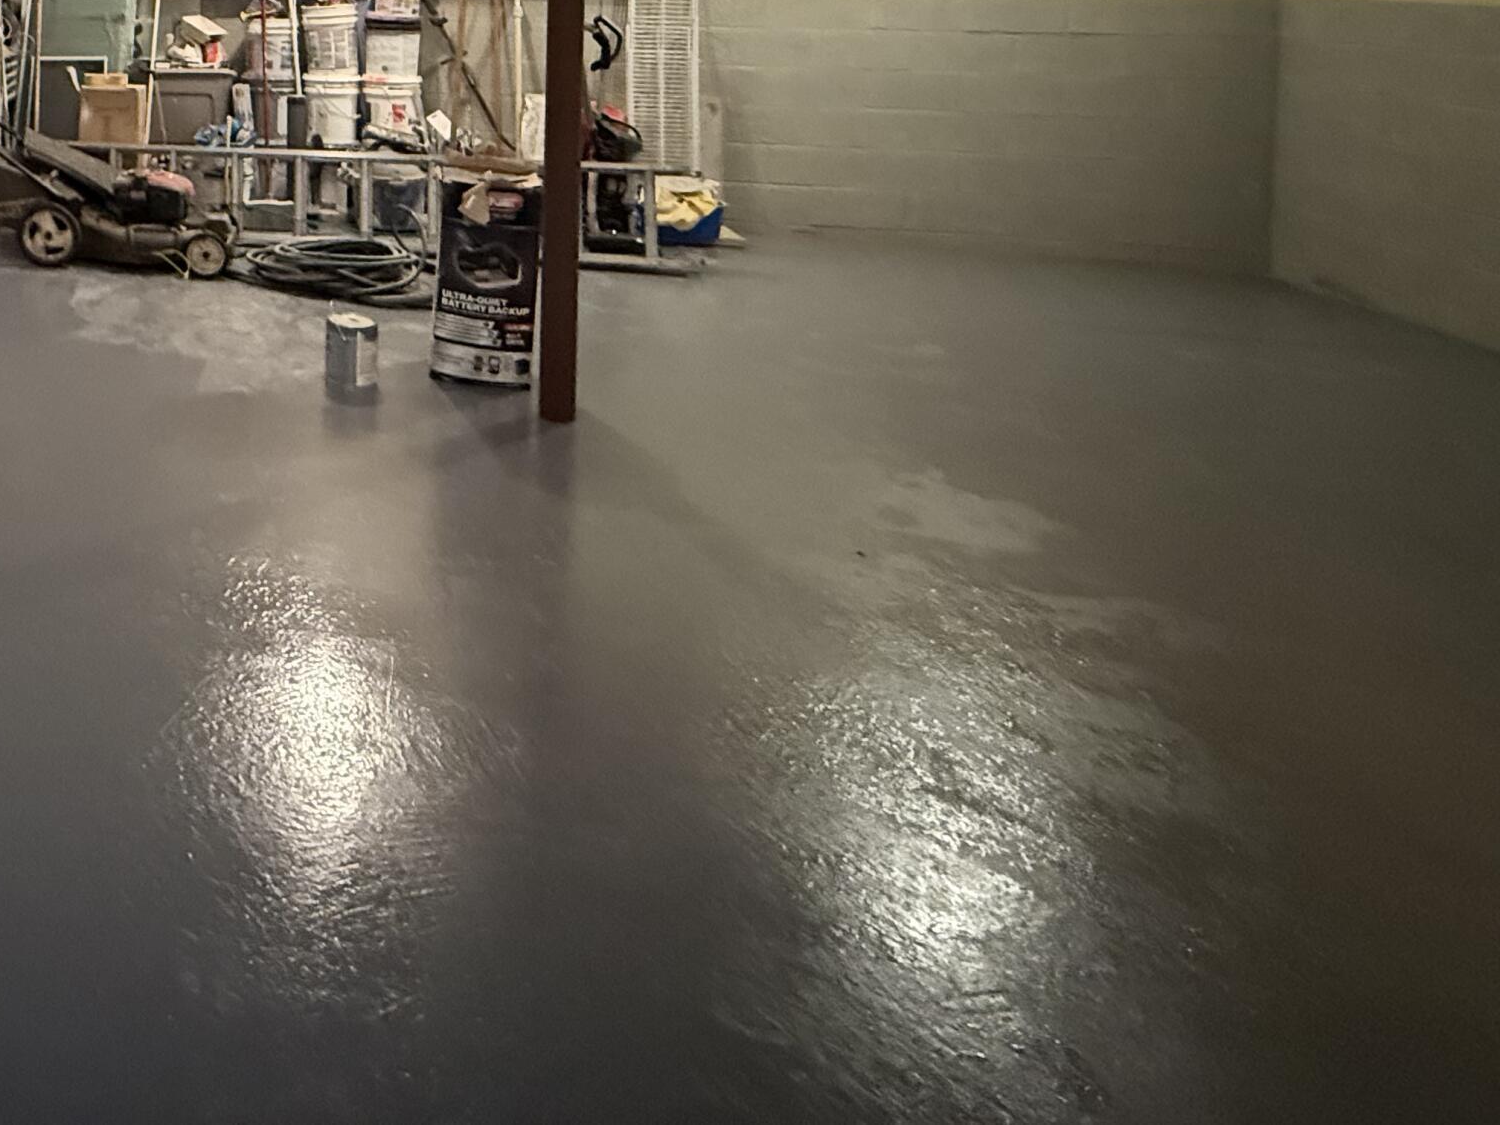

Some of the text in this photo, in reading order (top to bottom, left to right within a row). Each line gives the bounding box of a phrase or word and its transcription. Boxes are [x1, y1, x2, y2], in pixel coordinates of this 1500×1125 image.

[441, 288, 508, 306] ULTRA-QUIET
[441, 298, 530, 316] BATTERY BACKUP
